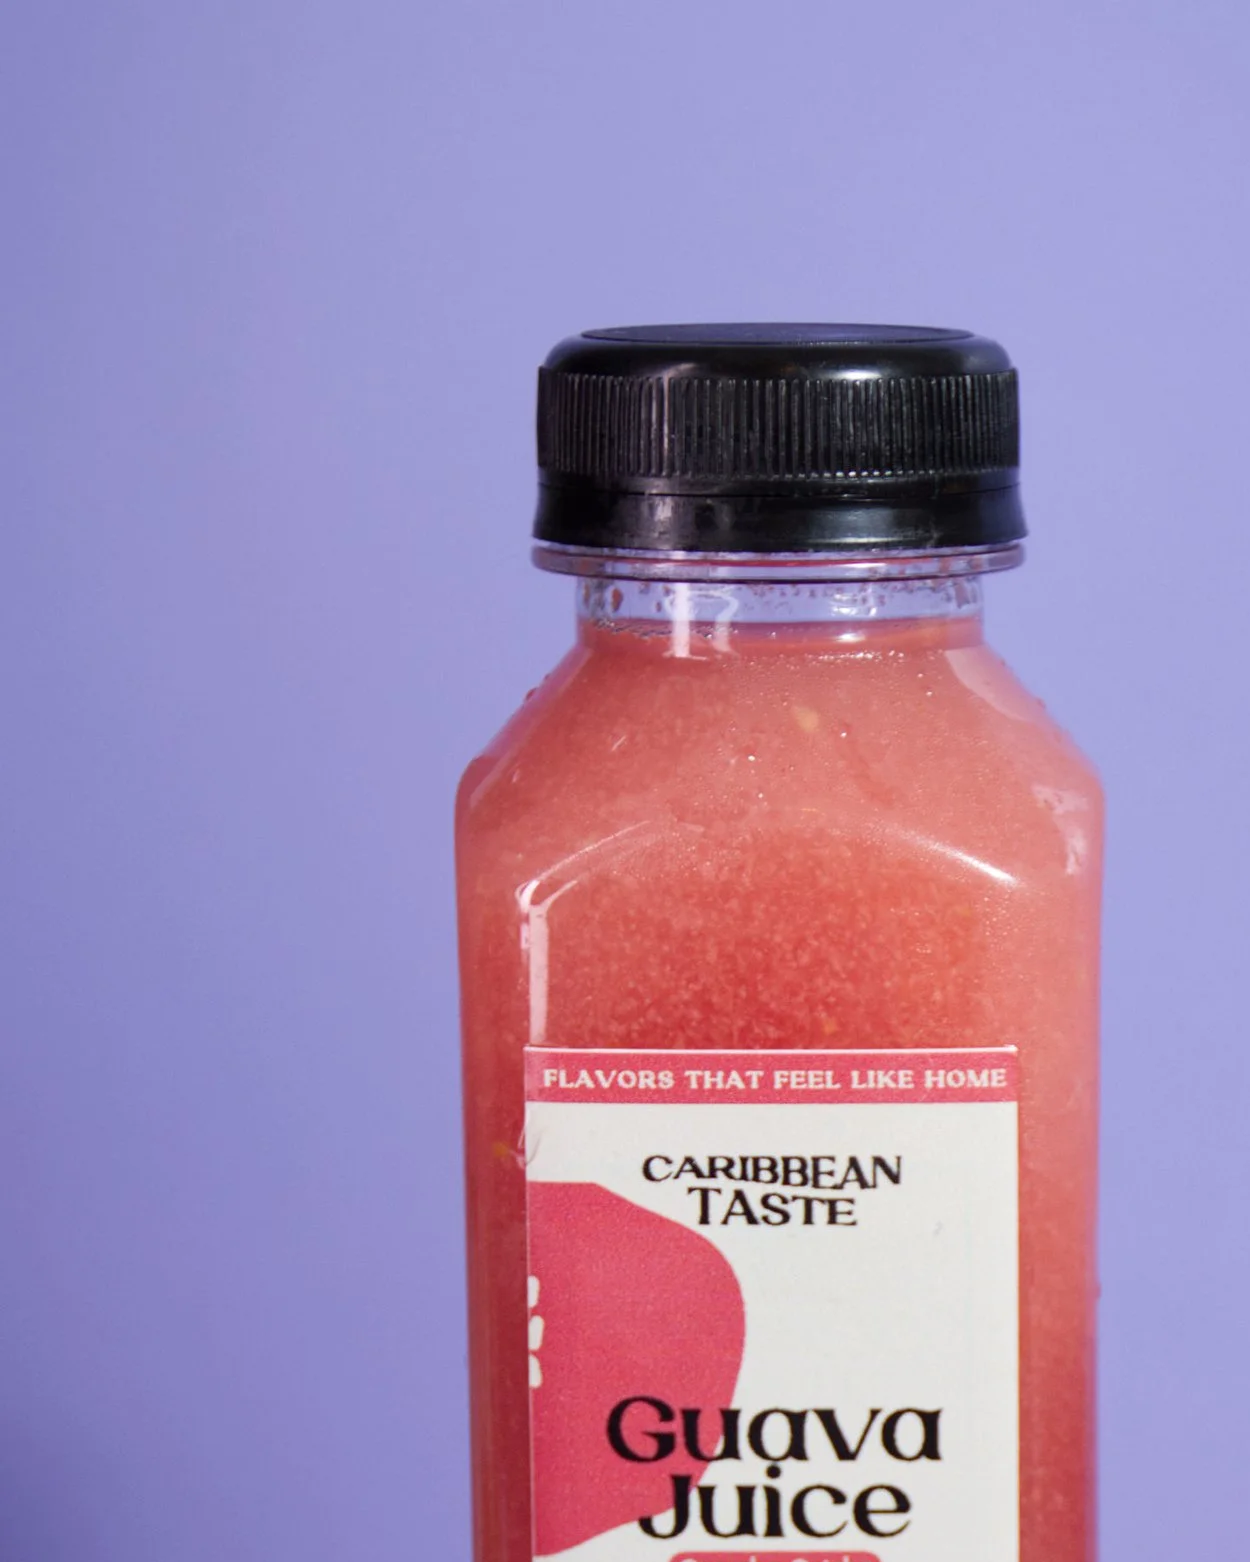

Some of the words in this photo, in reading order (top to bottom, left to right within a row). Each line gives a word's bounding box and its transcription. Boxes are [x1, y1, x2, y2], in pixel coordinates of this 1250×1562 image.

[543, 1069, 674, 1089] FLAVORS
[684, 1070, 764, 1089] THAT
[774, 1070, 841, 1089] FEEL
[851, 1070, 914, 1089] LIKE
[924, 1068, 1007, 1089] HOME
[642, 1155, 902, 1190] CARIBBEAN
[687, 1186, 858, 1227] TASTE
[606, 1395, 943, 1463] Guava
[638, 1463, 912, 1539] Juice
